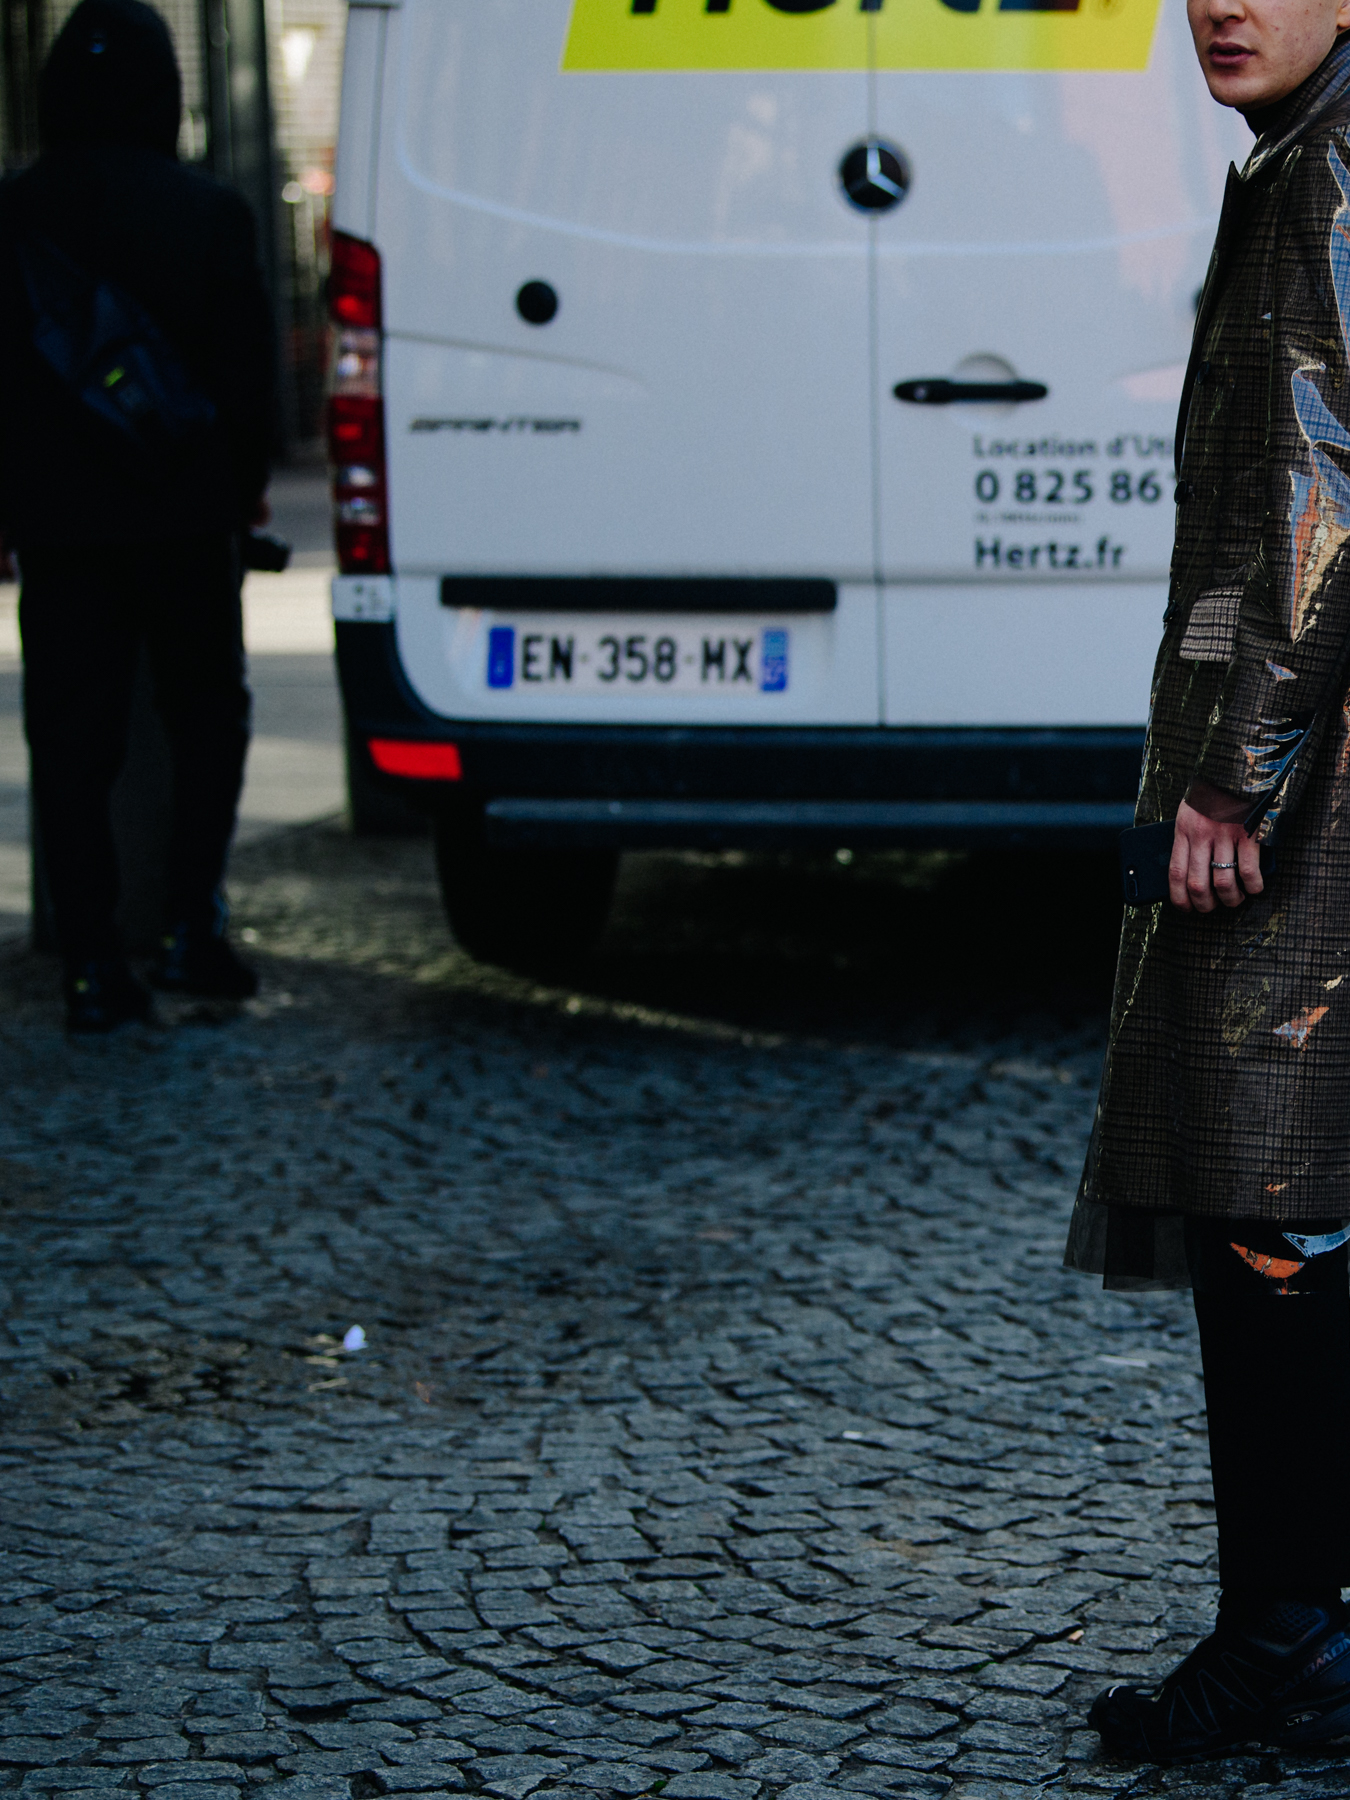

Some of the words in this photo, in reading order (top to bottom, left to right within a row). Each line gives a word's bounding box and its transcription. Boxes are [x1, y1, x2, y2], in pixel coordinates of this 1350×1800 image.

[973, 435, 1097, 457] Location
[1106, 435, 1175, 457] d'Uti
[976, 470, 999, 503] 0
[1015, 470, 1093, 503] 825
[1110, 470, 1175, 503] 86
[975, 537, 1124, 568] Hertz.fr
